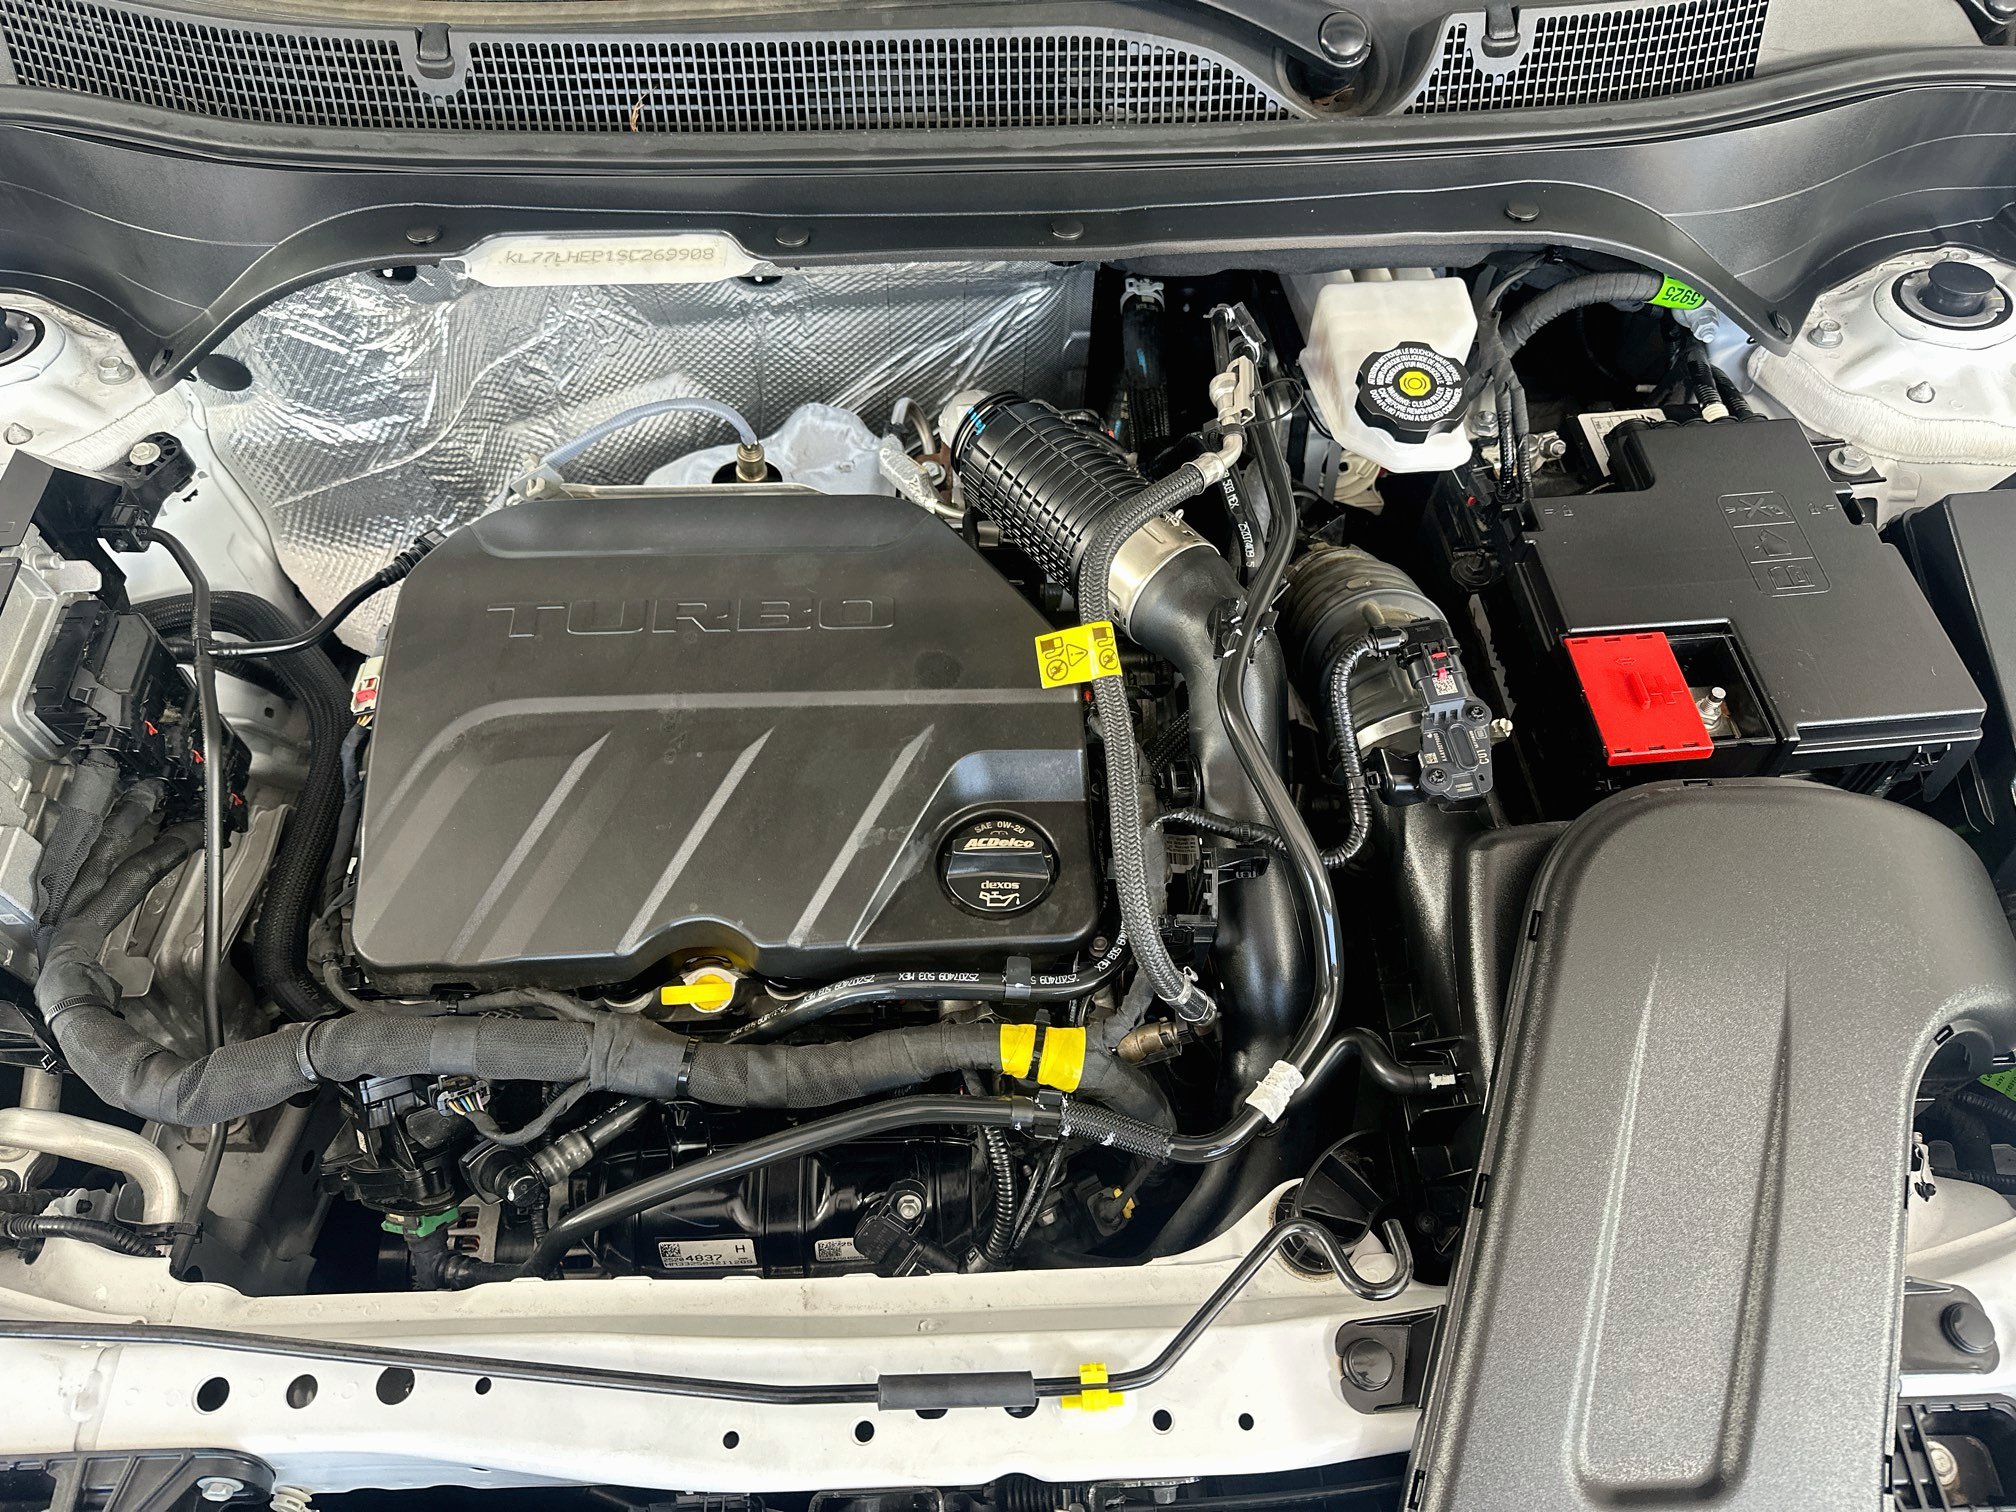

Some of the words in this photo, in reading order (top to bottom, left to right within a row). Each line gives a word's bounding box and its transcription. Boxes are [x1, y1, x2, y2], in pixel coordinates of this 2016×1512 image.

[505, 248, 714, 264] KL77LHEP1SC269908
[1662, 286, 1701, 305] 5925
[1401, 347, 1410, 355] LE
[1409, 347, 1437, 358] BOUCHON
[1432, 354, 1450, 367] AVANT
[1407, 354, 1429, 363] LIQUIDE
[1426, 357, 1436, 366] DE
[1377, 387, 1389, 398] CAP
[1384, 396, 1408, 412] BEFORE
[1411, 398, 1433, 408] CLEAN
[1429, 386, 1445, 403] FILLER
[1369, 388, 1381, 401] DOT
[1378, 401, 1396, 415] FLUID
[1394, 410, 1414, 421] FROM
[1414, 414, 1420, 422] A
[1419, 409, 1444, 422] SEALED
[1222, 478, 1235, 494] 503
[1227, 493, 1240, 509] MEX
[487, 597, 895, 637] TURBO
[974, 821, 993, 834] SAE
[963, 837, 1035, 849] ACDelco
[980, 880, 1021, 890] dexos
[1093, 958, 1112, 972] MEX
[898, 972, 915, 981] MEX
[918, 973, 935, 981] 503
[938, 973, 980, 982] 25207409
[735, 1244, 746, 1253] H
[685, 1254, 723, 1262] 4837
